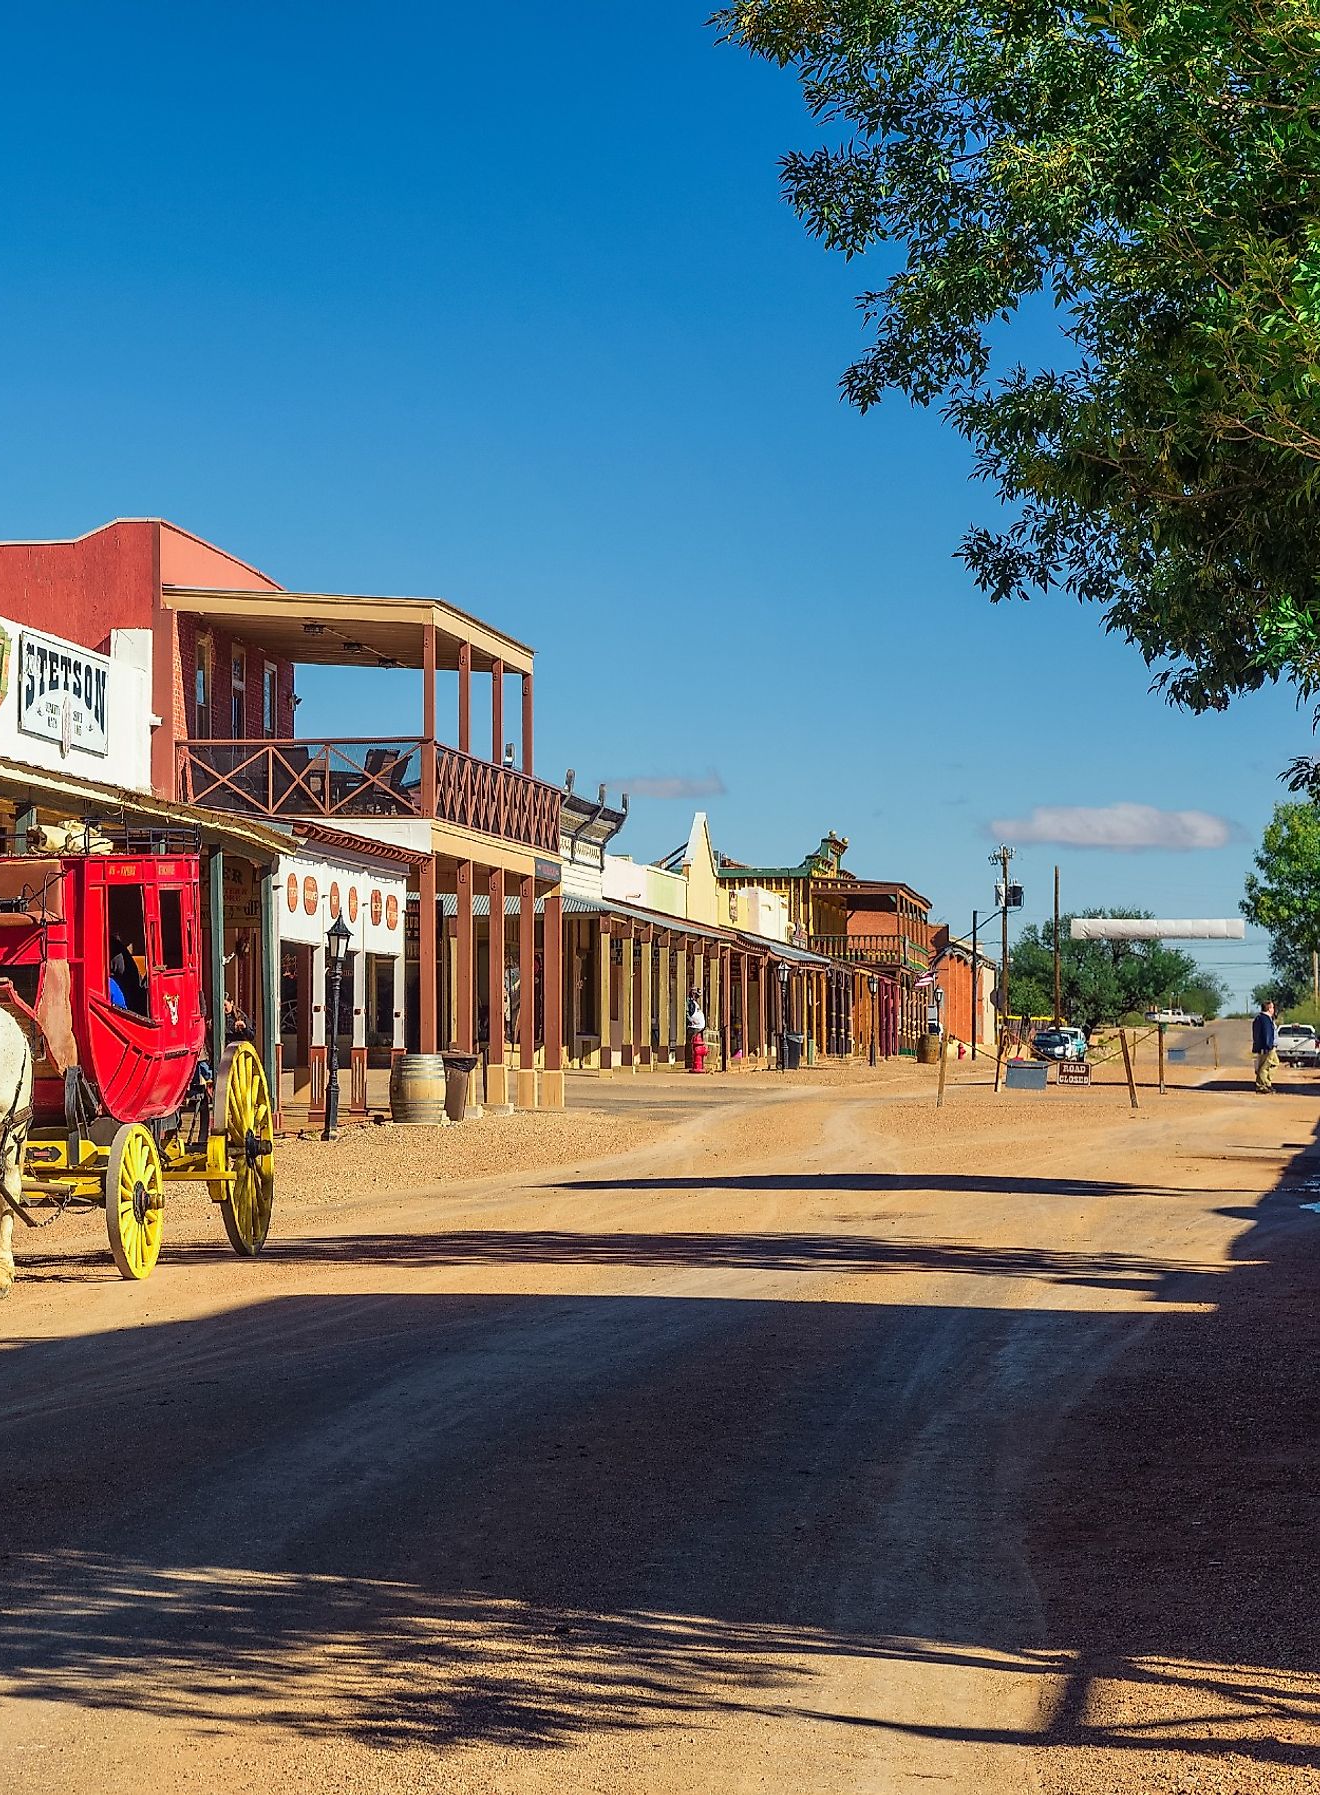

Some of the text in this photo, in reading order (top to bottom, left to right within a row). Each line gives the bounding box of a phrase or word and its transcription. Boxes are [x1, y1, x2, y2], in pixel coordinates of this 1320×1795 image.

[25, 641, 107, 736] STETSON
[1063, 1065, 1086, 1073] ROAD
[1060, 1075, 1089, 1084] CLOSED
